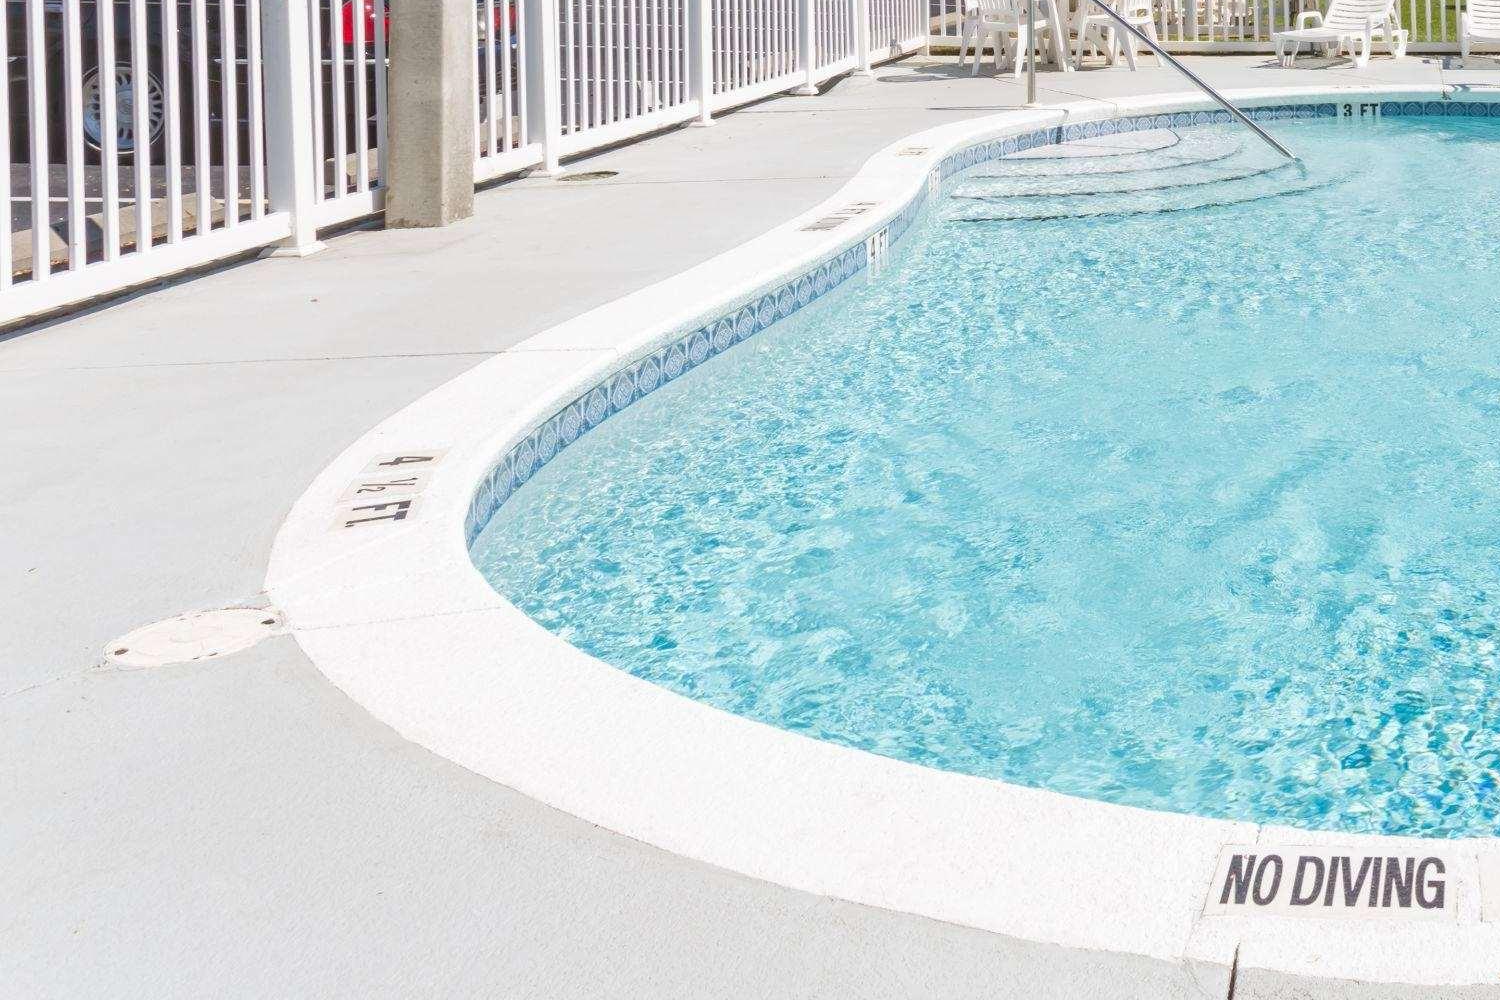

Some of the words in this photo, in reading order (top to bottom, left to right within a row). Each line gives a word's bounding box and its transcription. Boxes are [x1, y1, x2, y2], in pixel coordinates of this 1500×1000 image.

[1343, 103, 1353, 117] 3
[1360, 103, 1378, 117] FT
[1221, 854, 1284, 905] NO
[1289, 855, 1446, 910] DIVING
